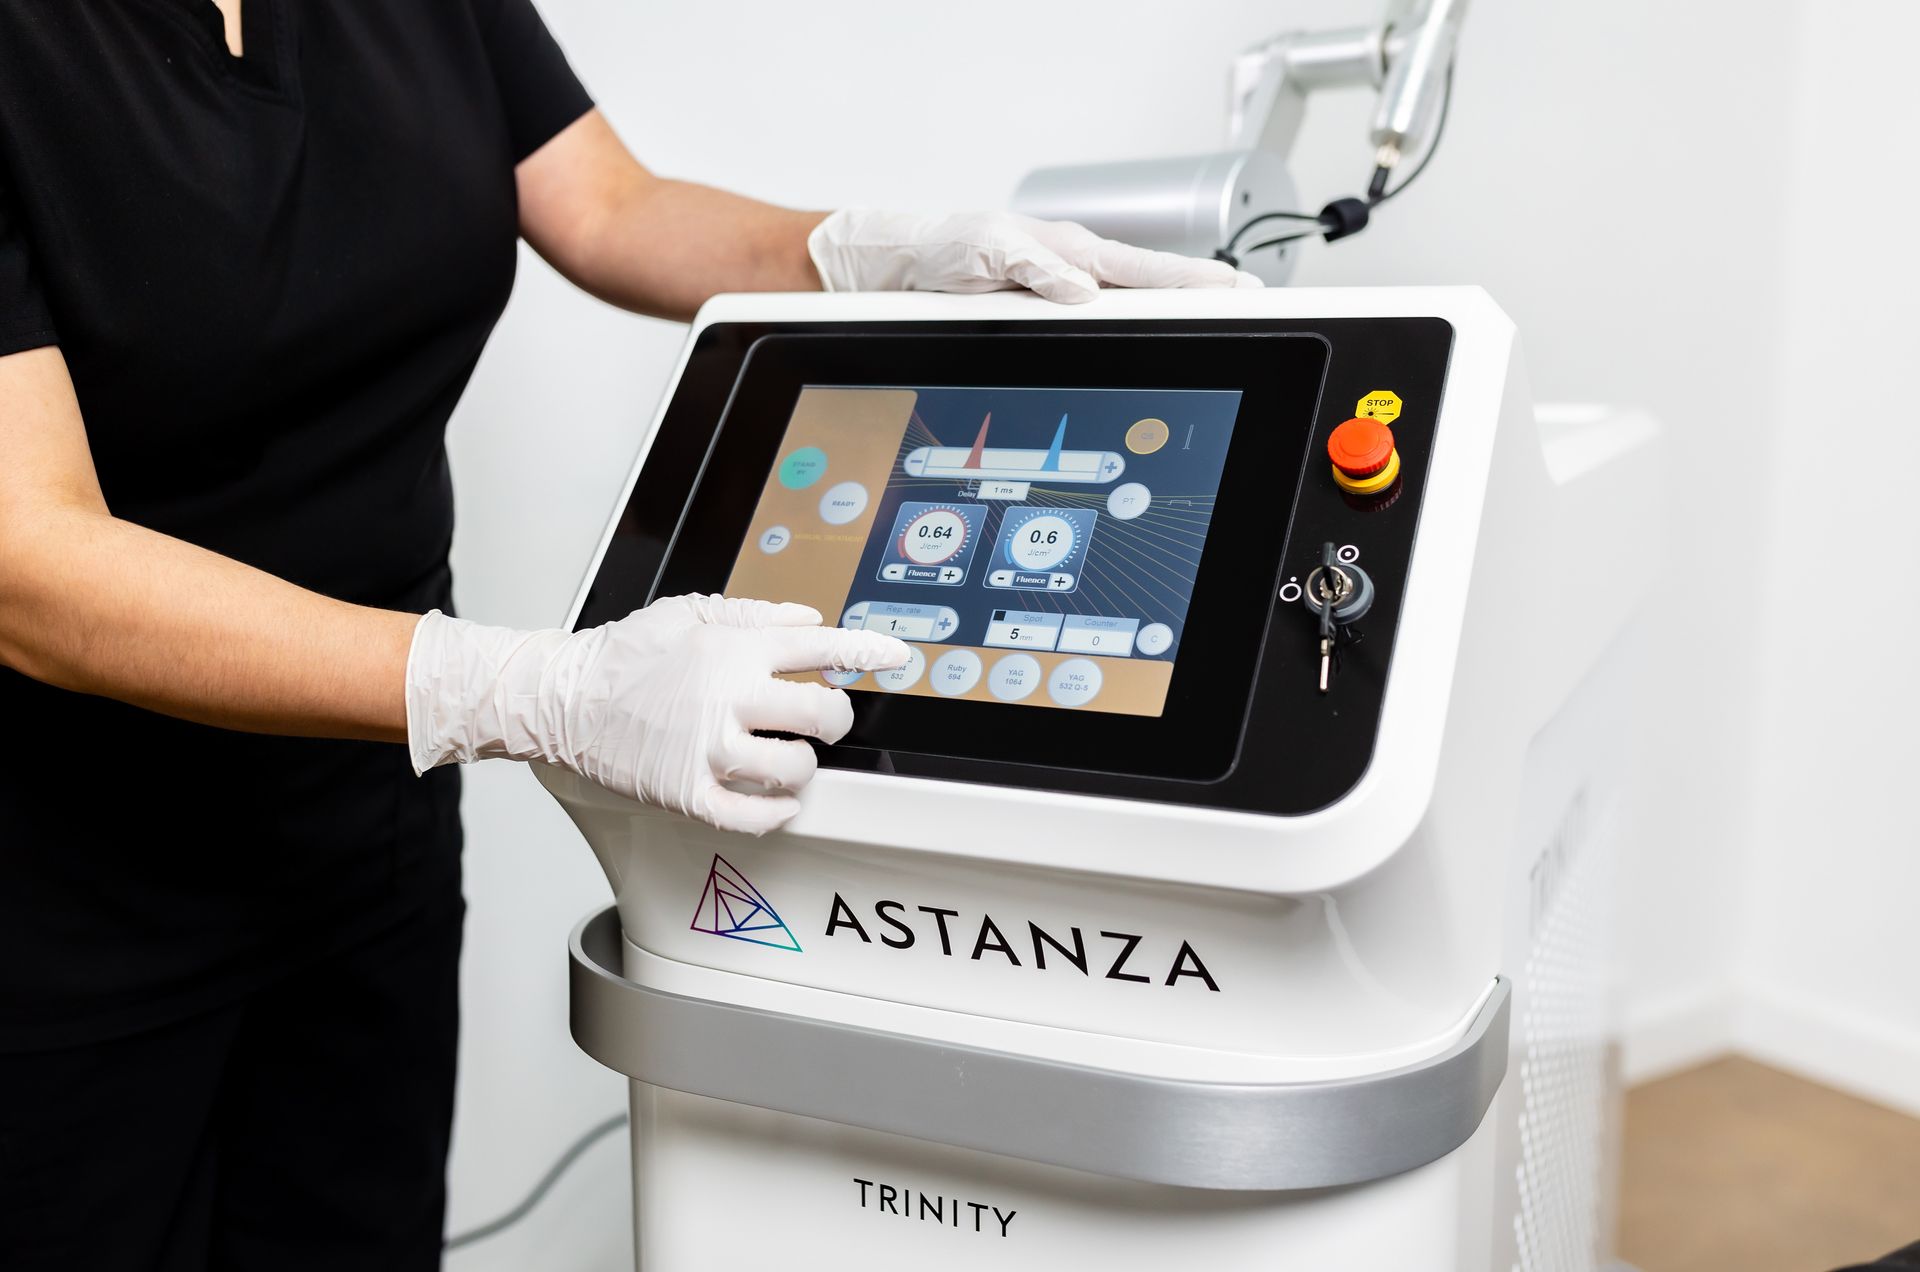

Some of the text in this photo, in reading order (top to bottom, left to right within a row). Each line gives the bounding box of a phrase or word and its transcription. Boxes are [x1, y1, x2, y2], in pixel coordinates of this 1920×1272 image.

[1366, 399, 1394, 407] STOP
[957, 489, 977, 499] Delay
[918, 525, 953, 540] 0.64
[1029, 530, 1059, 545] 0.6
[907, 569, 937, 579] Fluence
[1015, 575, 1046, 585] Fluence
[905, 607, 922, 615] rate
[1023, 614, 1043, 623] Spot
[1084, 618, 1119, 628] Counter
[890, 619, 897, 631] 1
[1009, 628, 1033, 642] 5 mm
[1150, 635, 1158, 643] C
[1092, 636, 1100, 646] 0
[947, 664, 967, 673] Ruby
[1008, 669, 1024, 677] YAG
[890, 673, 904, 681] 532
[1005, 678, 1022, 686] 1064
[1068, 674, 1085, 682] YAG
[1059, 682, 1073, 691] 532
[825, 891, 1221, 993] ASTANZA
[853, 1178, 1017, 1238] TRINITY
